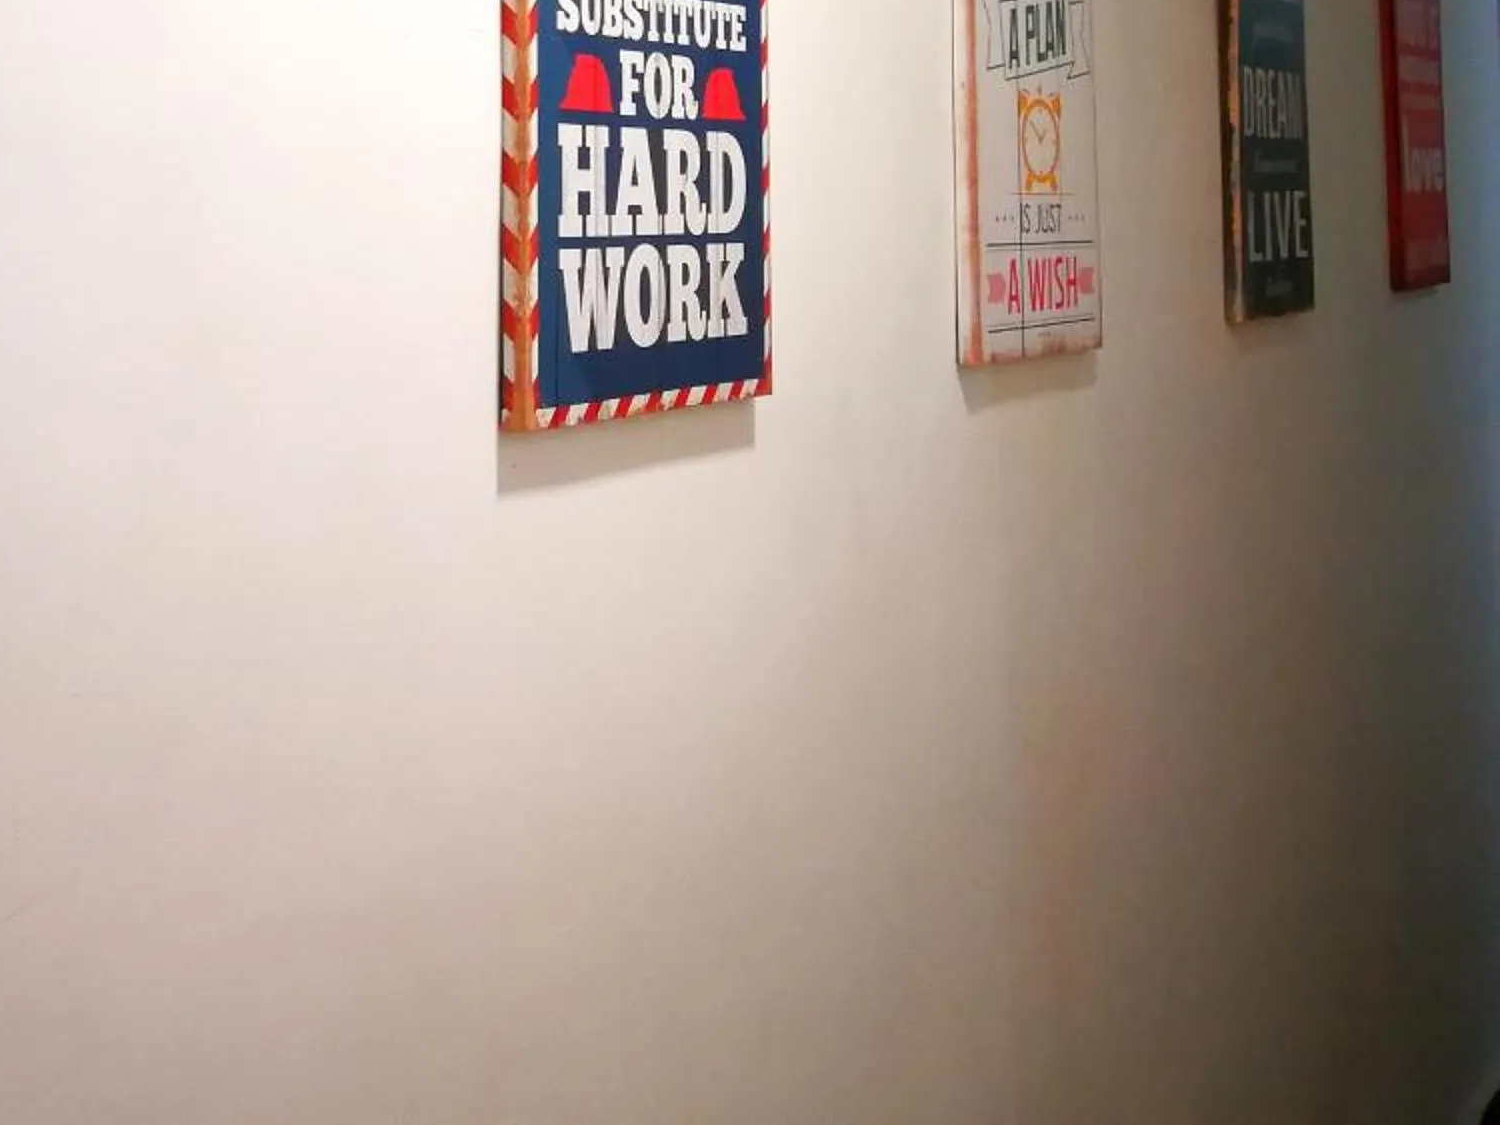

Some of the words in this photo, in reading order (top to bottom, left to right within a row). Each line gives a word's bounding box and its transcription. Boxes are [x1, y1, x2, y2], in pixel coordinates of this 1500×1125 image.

[1008, 7, 1020, 70] A
[618, 50, 699, 122] FOR
[1243, 66, 1302, 140] DREAM
[556, 122, 746, 239] HARD
[1020, 203, 1031, 234] IS
[1034, 203, 1062, 234] JUST
[1247, 190, 1308, 262] LIVE
[557, 240, 748, 355] WORK
[1008, 257, 1021, 315] A
[1027, 255, 1078, 312] WISH
